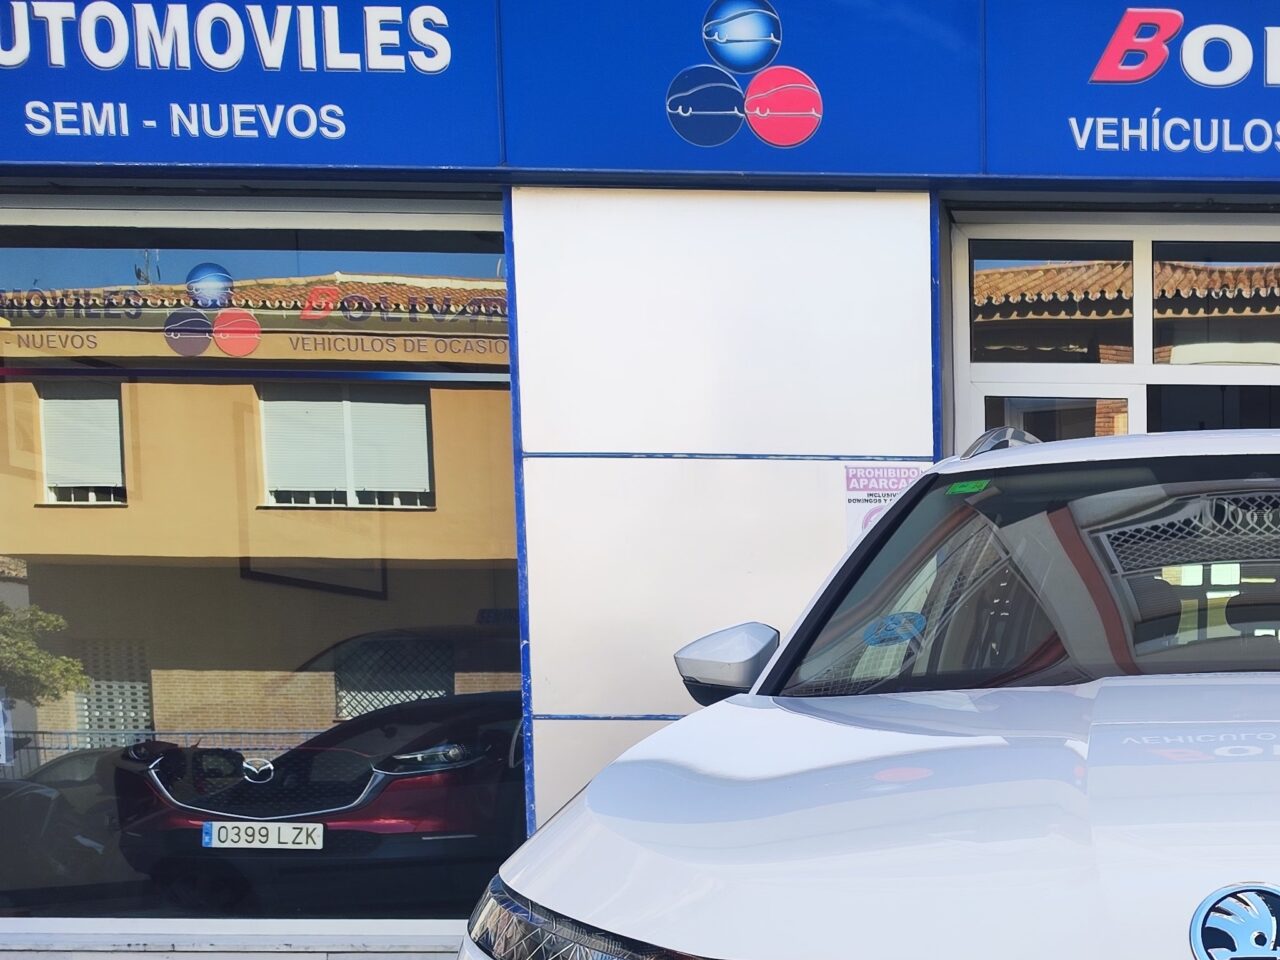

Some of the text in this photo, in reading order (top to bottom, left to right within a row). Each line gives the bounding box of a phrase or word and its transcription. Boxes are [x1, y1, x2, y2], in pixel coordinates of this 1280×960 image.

[25, 100, 130, 137] SEMI
[170, 103, 346, 140] NUEVOS
[17, 334, 98, 349] NUEVOS
[288, 336, 397, 353] VEHICULOS
[404, 338, 428, 353] DE
[848, 468, 919, 478] PROHIBIDO
[217, 825, 317, 845] 0399 LZK
